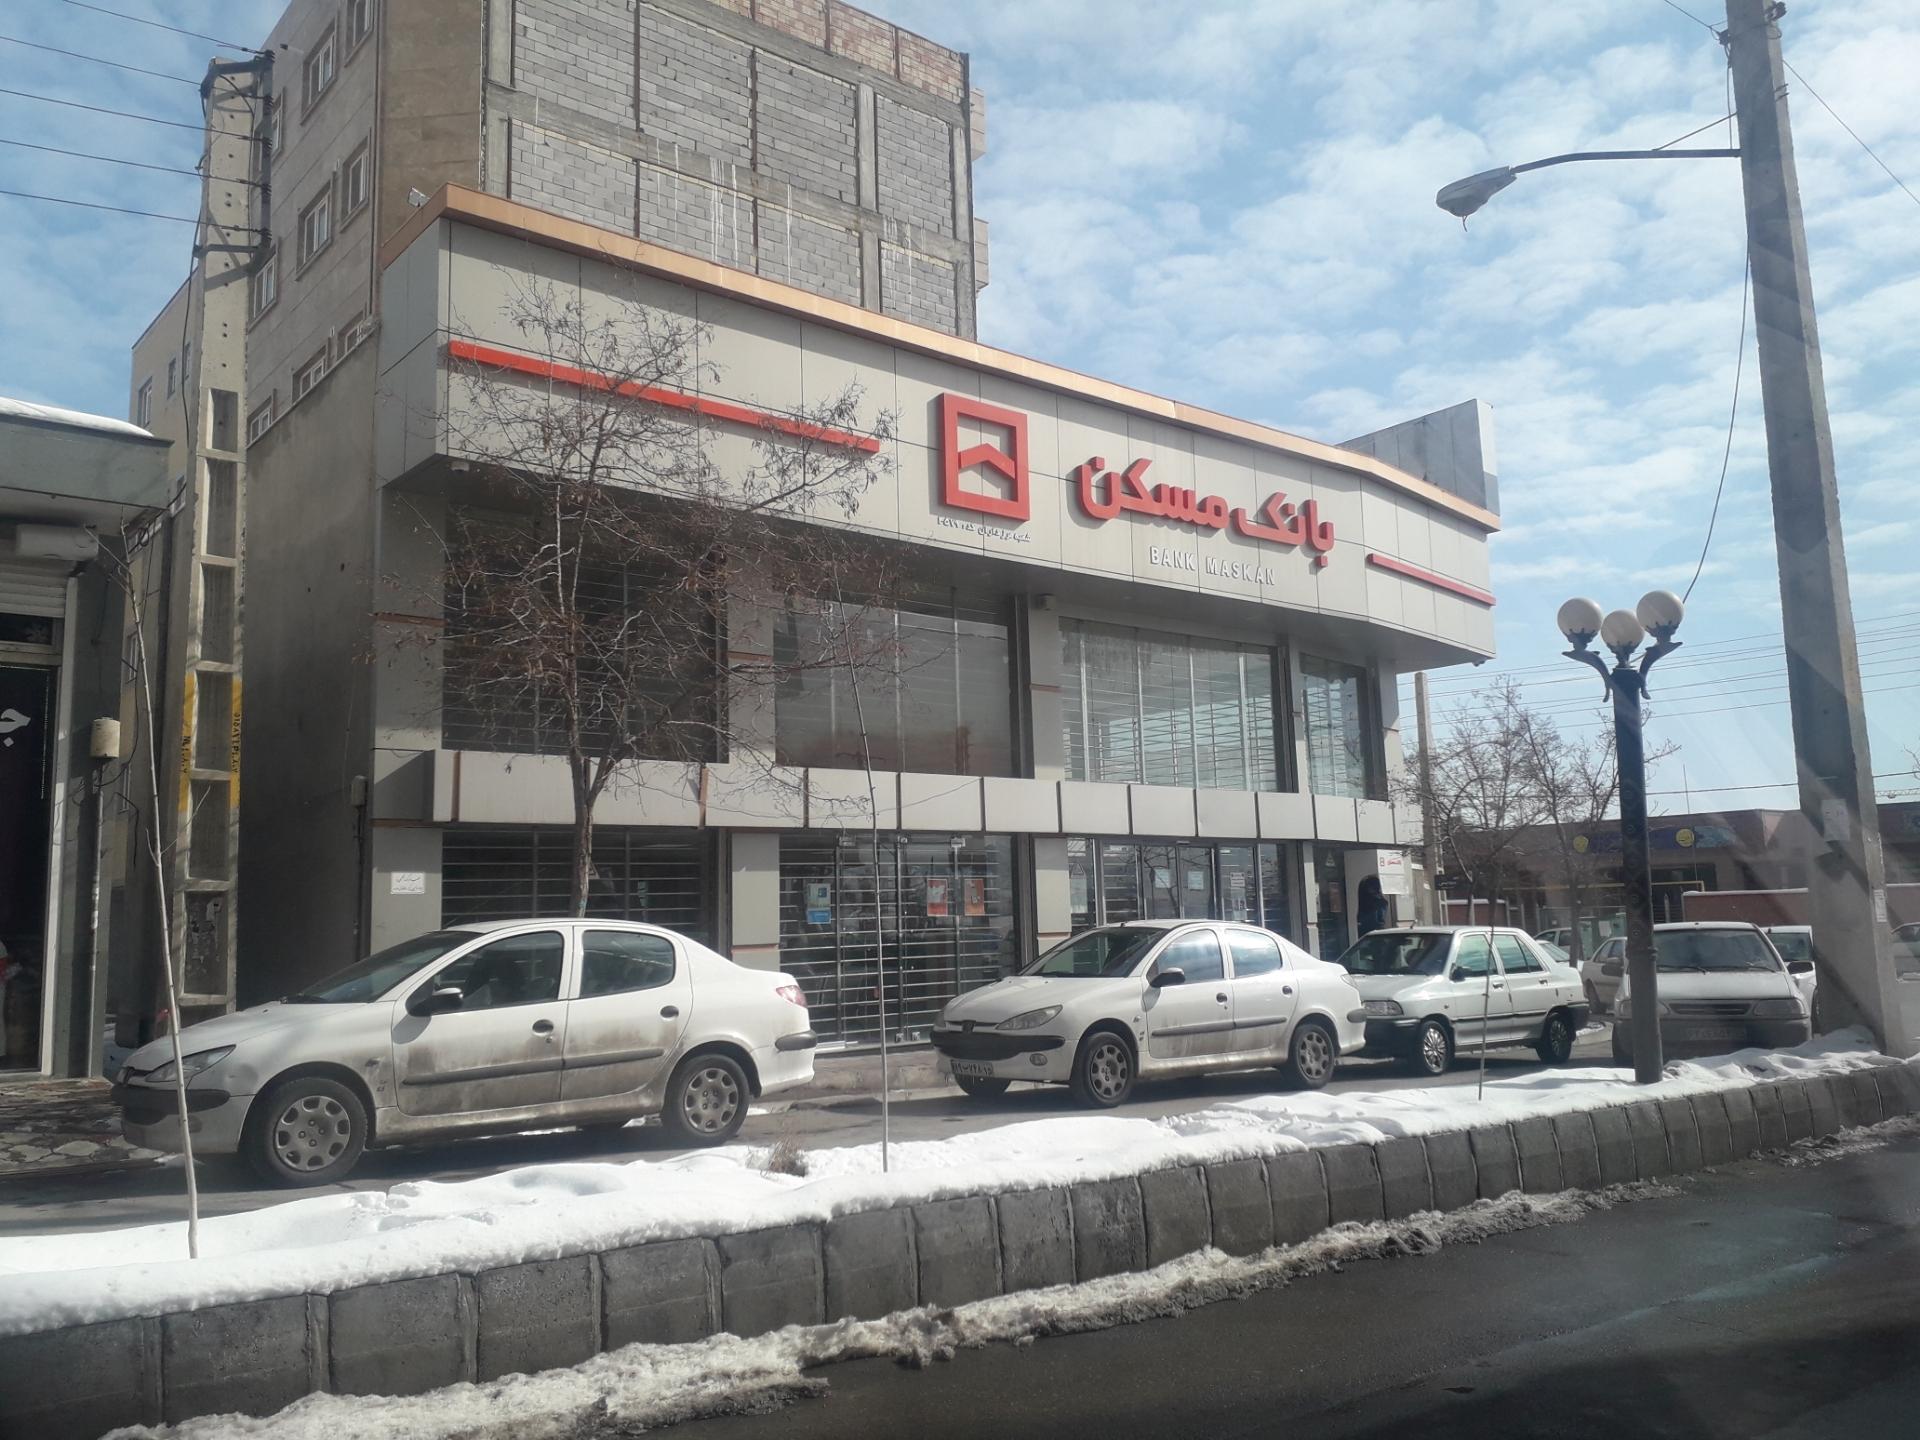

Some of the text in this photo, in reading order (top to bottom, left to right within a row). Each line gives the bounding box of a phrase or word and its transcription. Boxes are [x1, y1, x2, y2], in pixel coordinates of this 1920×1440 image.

[1078, 456, 1335, 568] بانک مسکن
[1150, 546, 1275, 585] BANK MASKAN
